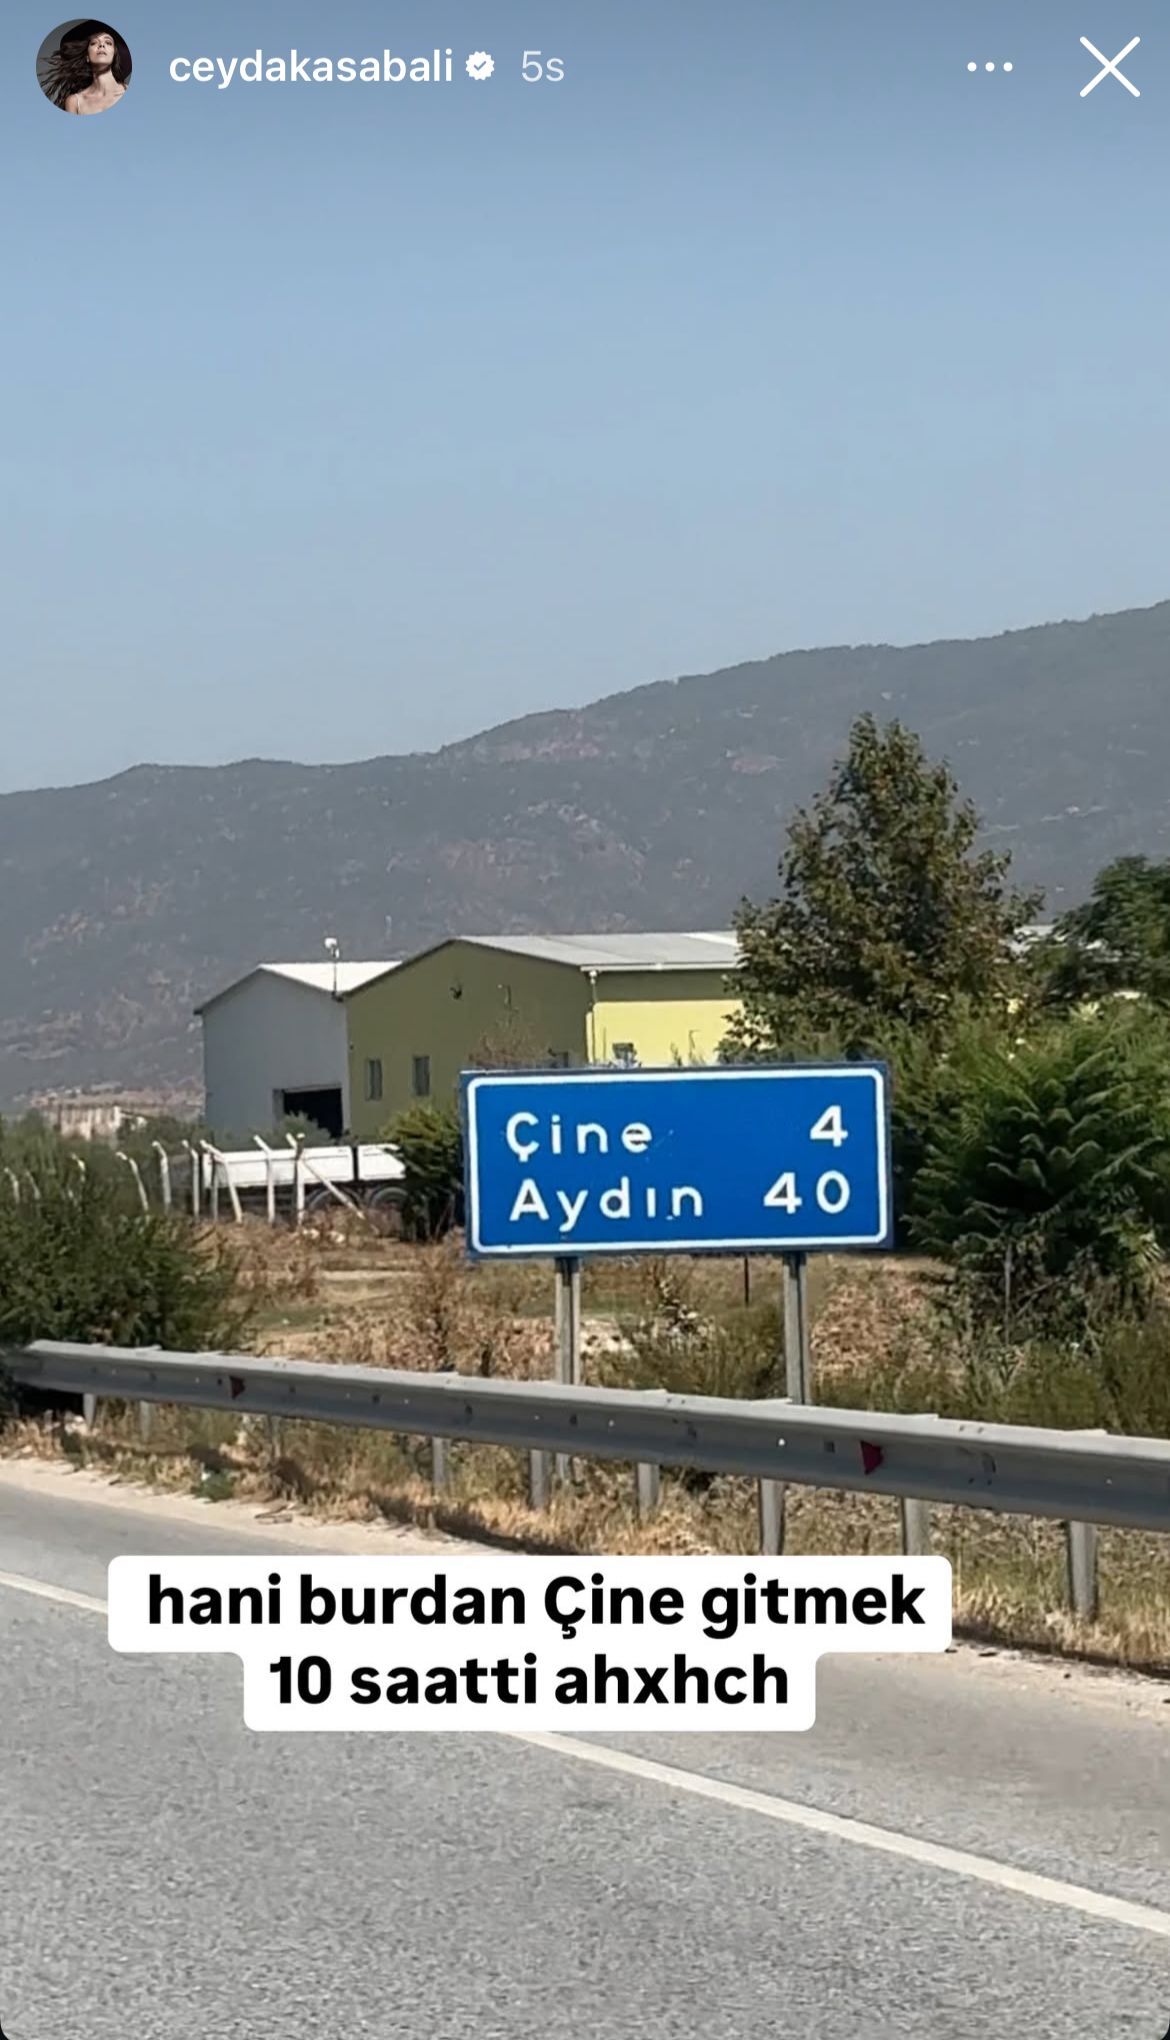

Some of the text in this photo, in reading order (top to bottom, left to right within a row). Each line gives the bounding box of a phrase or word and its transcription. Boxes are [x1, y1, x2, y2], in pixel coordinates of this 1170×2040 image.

[506, 1105, 848, 1162] Çine 4
[510, 1170, 850, 1232] Aydın 40
